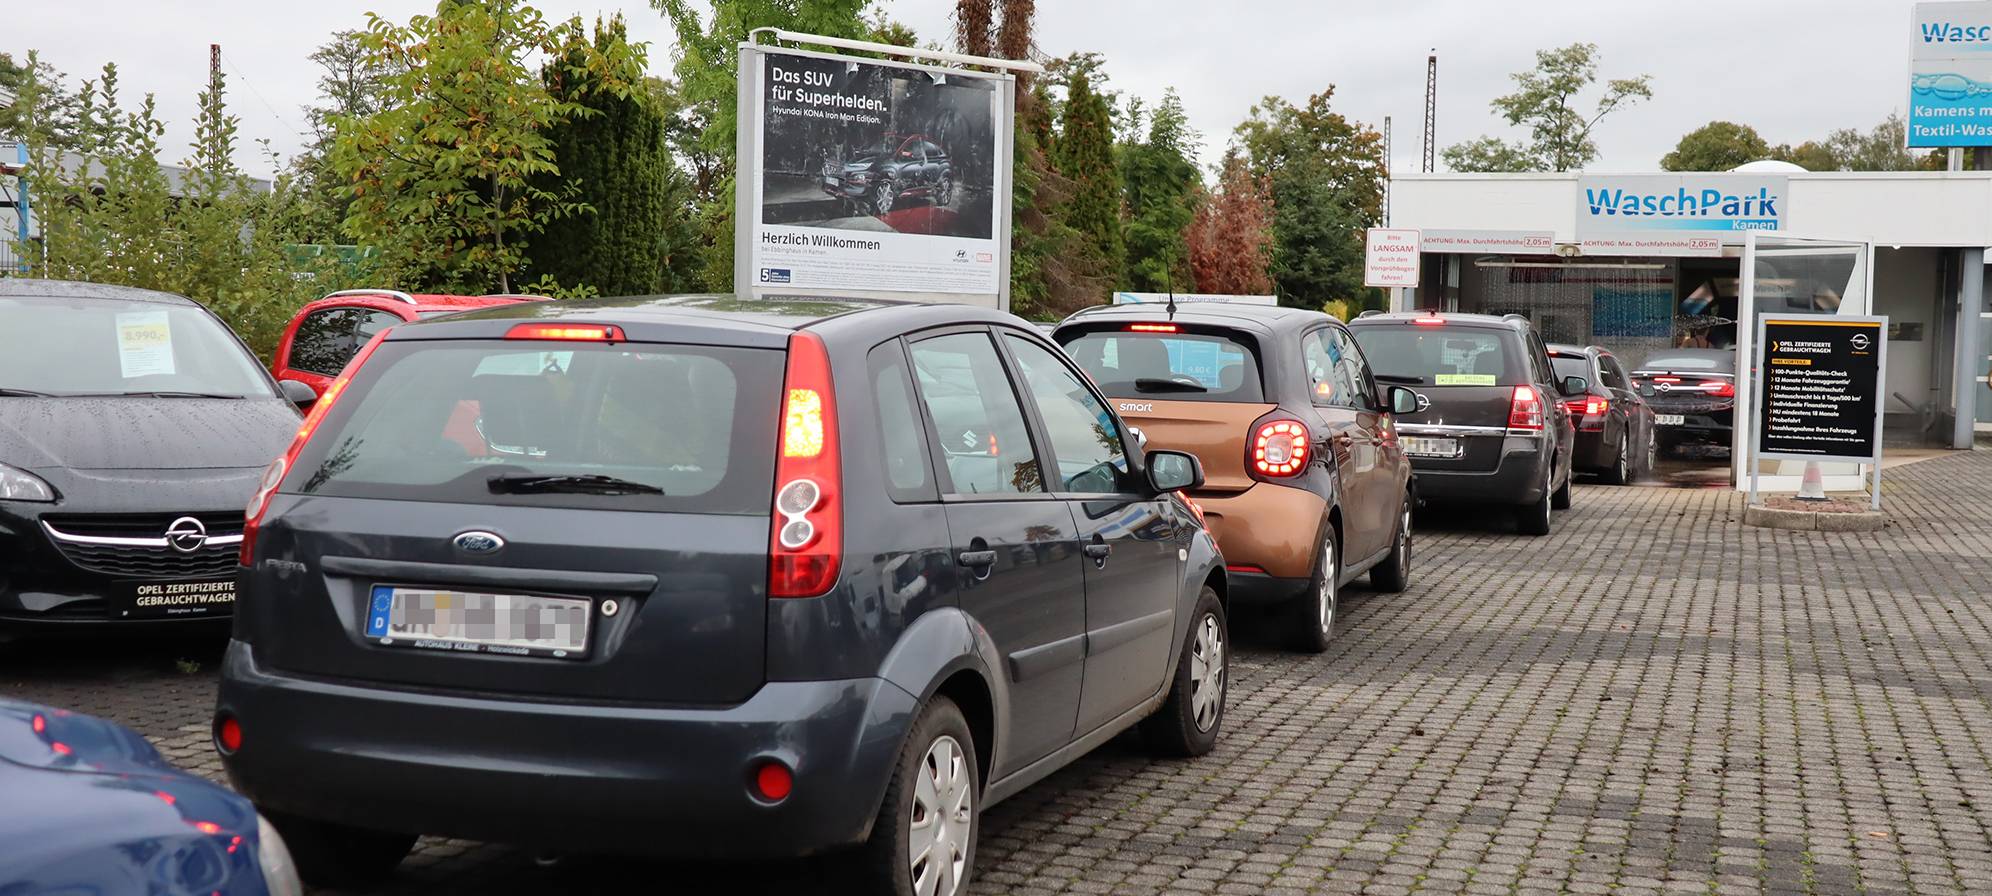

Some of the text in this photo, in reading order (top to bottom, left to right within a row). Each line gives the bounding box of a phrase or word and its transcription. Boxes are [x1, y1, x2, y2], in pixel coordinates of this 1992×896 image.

[772, 67, 833, 87] Das SUV
[772, 85, 887, 111] für Superhelden.
[772, 105, 881, 124] Hyundai KONA Iron Man Edition.
[1914, 105, 1975, 117] Kamens
[1586, 187, 1777, 216] WaschPark
[1732, 219, 1775, 230] Kamen
[762, 232, 880, 250] Herzlich Willkommen
[761, 269, 769, 281] 5
[1119, 402, 1152, 412] smart
[1804, 402, 1838, 410] Finanzierung
[1772, 425, 1815, 433] Inzahlungnahme
[1829, 427, 1857, 435] Fahrzeugs
[463, 535, 490, 549] Ford
[137, 581, 235, 595] OPEL ZERTIFIZIERTE
[136, 593, 235, 606] GEBRAUCHTWAGEN
[375, 617, 384, 628] D
[415, 639, 452, 649] AUTOHAUS
[454, 641, 479, 651] KLEINE
